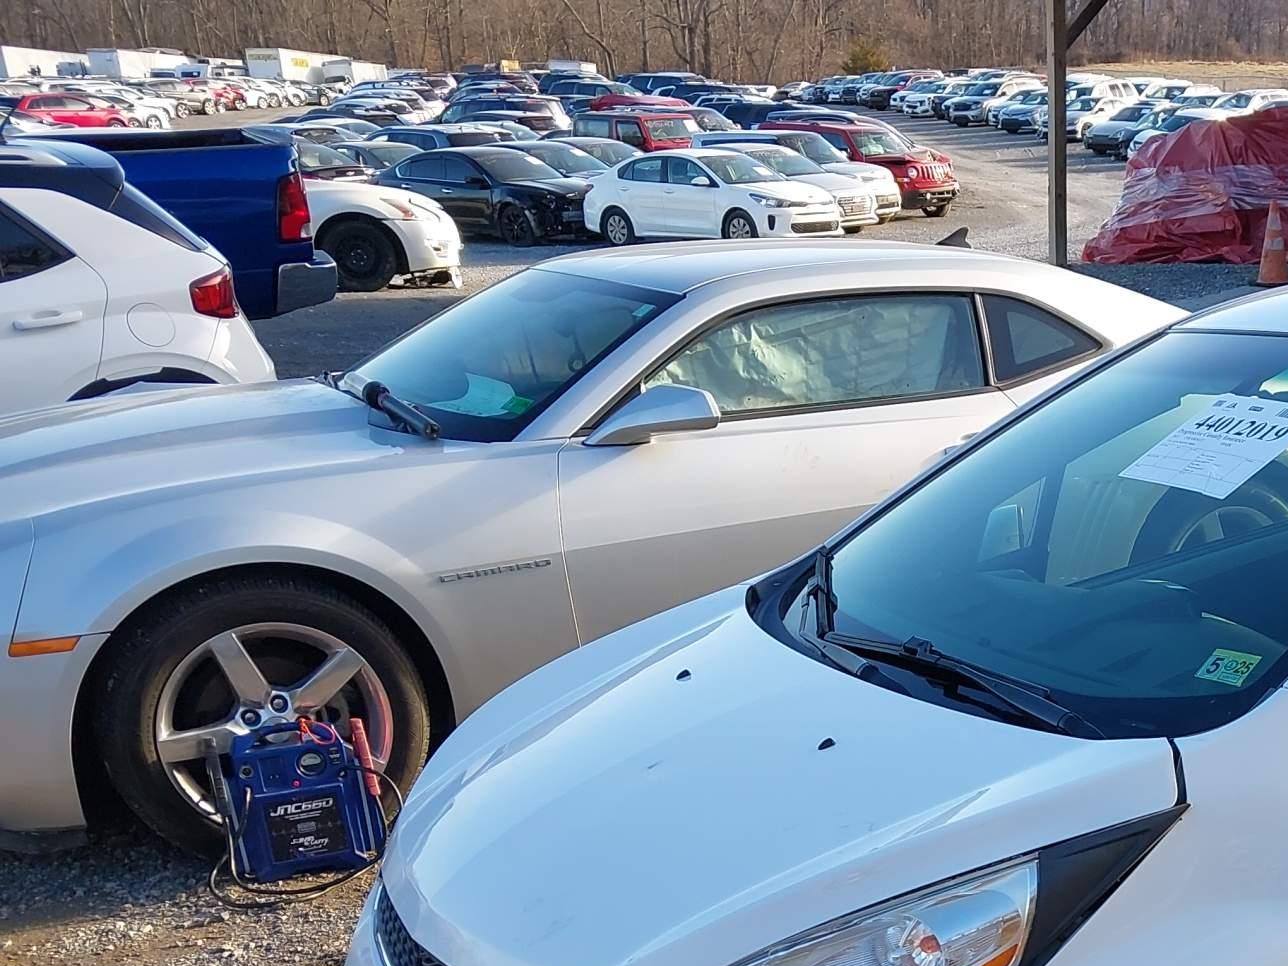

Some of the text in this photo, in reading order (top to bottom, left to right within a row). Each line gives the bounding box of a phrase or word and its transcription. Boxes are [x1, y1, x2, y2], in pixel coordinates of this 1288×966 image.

[439, 559, 552, 583] CAMARO
[1206, 657, 1254, 675] 5 25
[270, 797, 333, 817] JNC660
